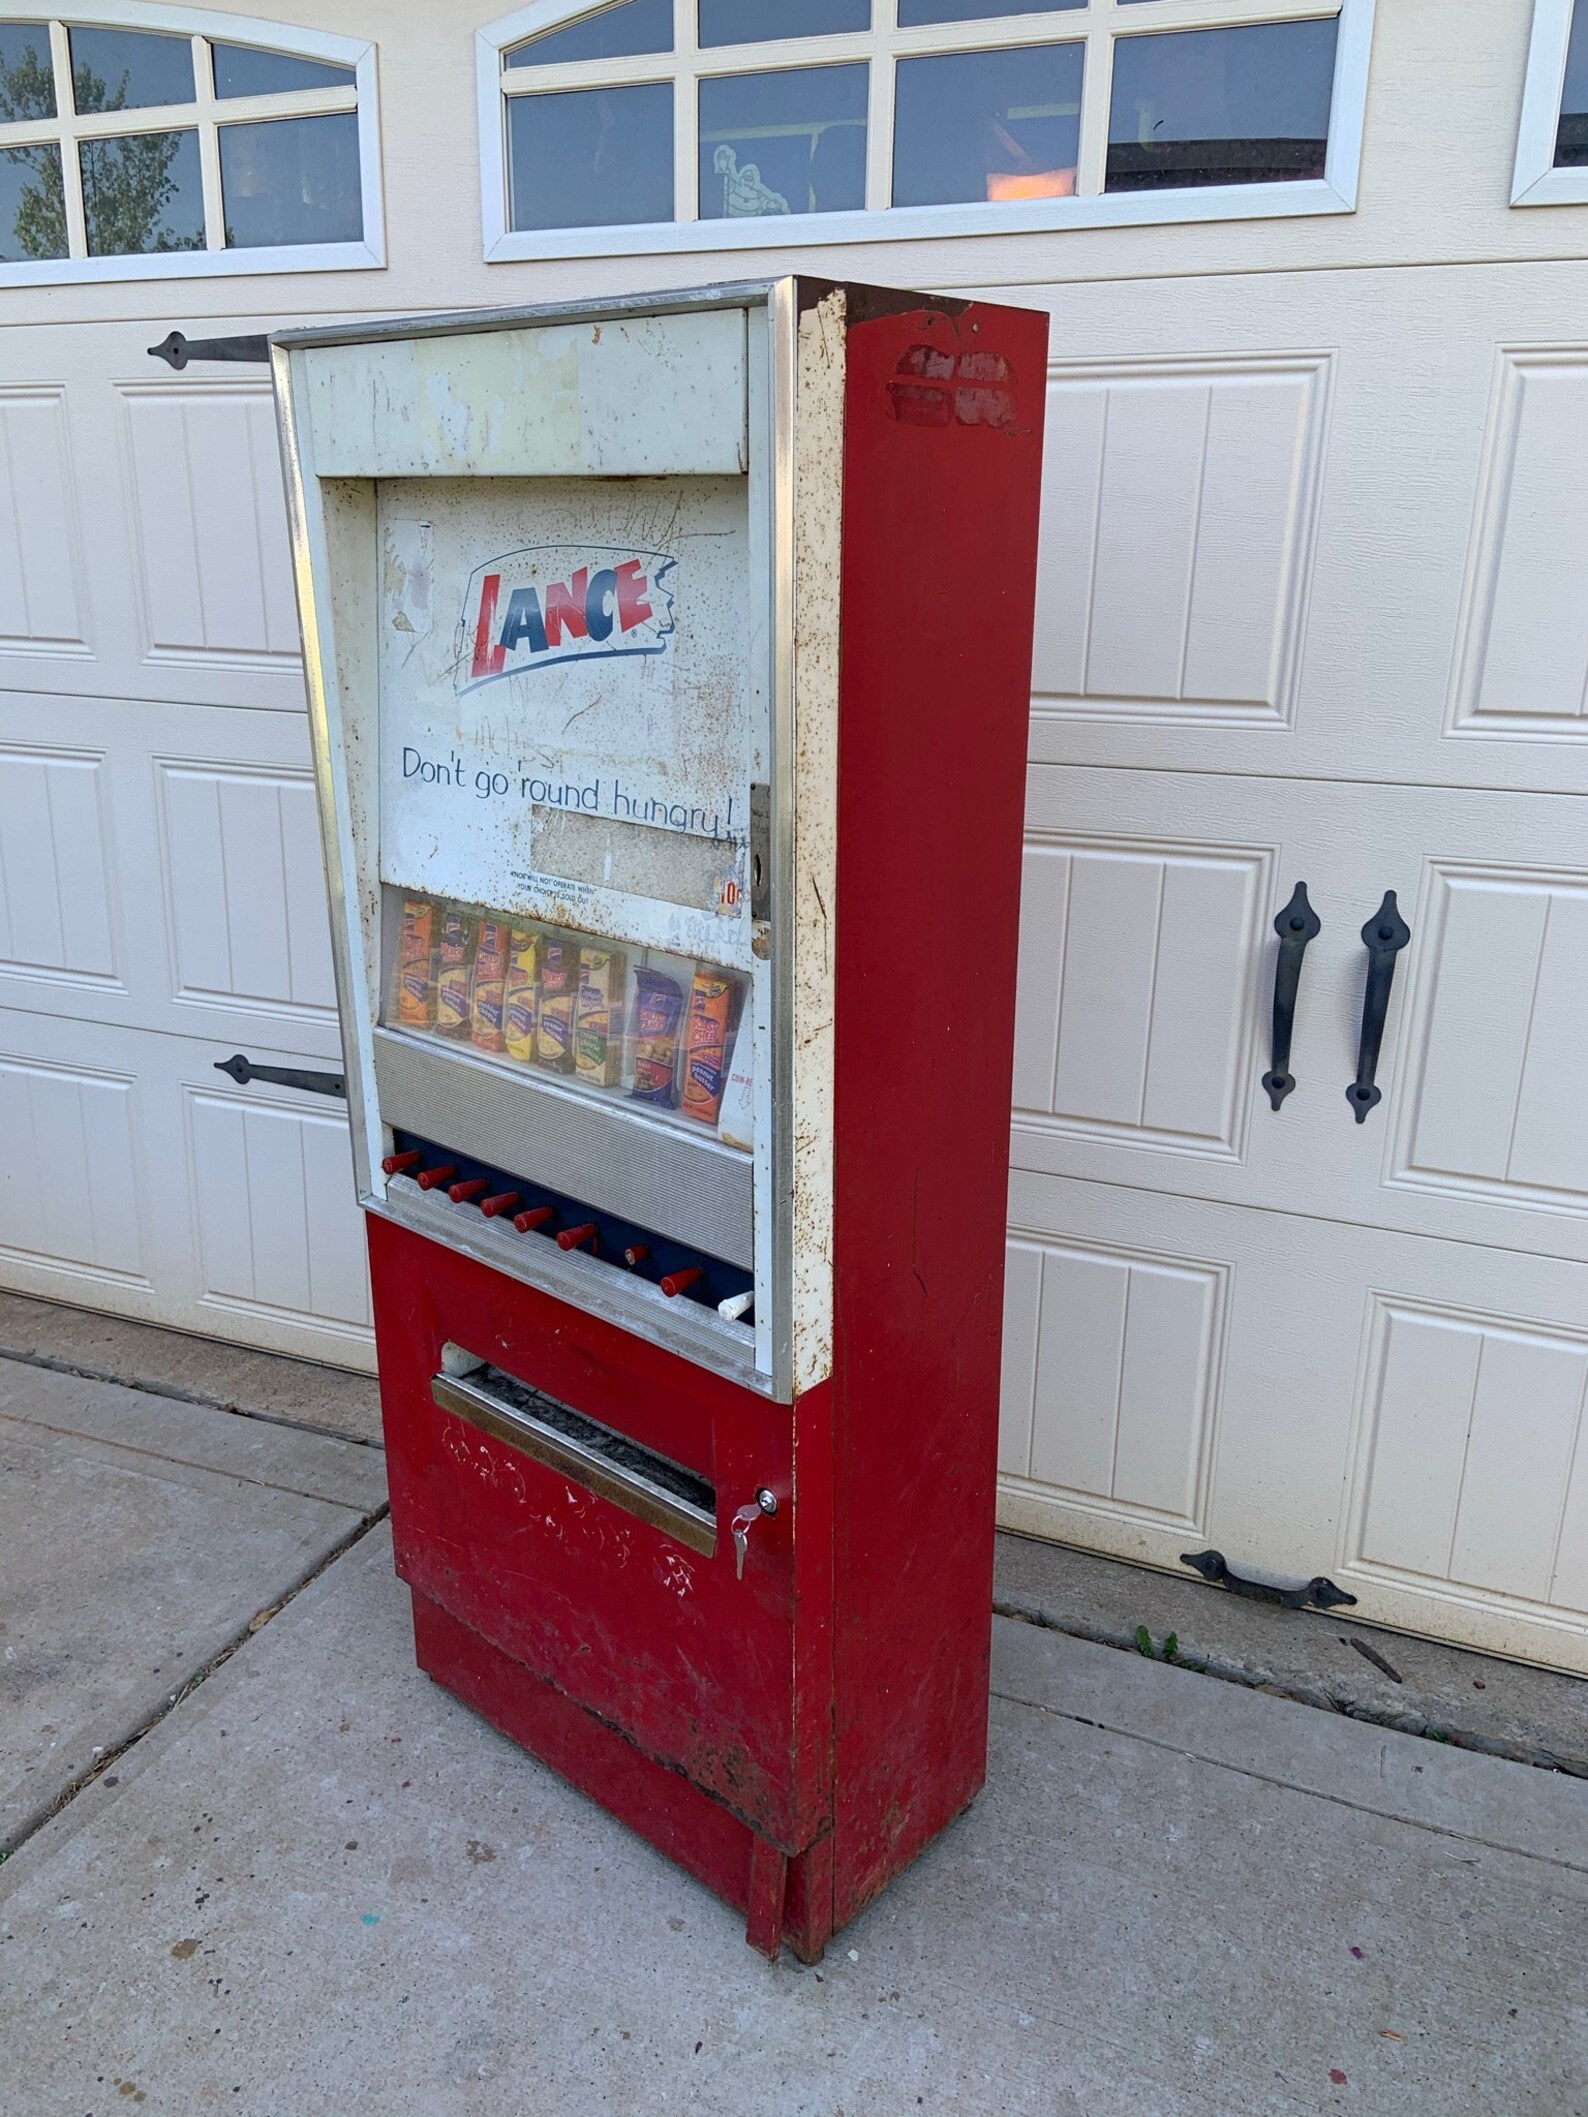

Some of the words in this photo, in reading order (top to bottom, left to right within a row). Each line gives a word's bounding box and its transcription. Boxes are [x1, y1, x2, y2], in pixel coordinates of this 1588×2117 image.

[471, 558, 653, 678] LANCE
[402, 746, 466, 788] Don't
[475, 770, 509, 798] go
[614, 779, 733, 846] hungry!
[517, 883, 532, 892] YOUR
[560, 892, 576, 902] SOLD
[577, 894, 589, 905] OUT
[527, 875, 538, 883] WILL
[540, 877, 552, 885] NOT
[553, 880, 576, 891] OPERATE
[577, 885, 594, 895] WHEN
